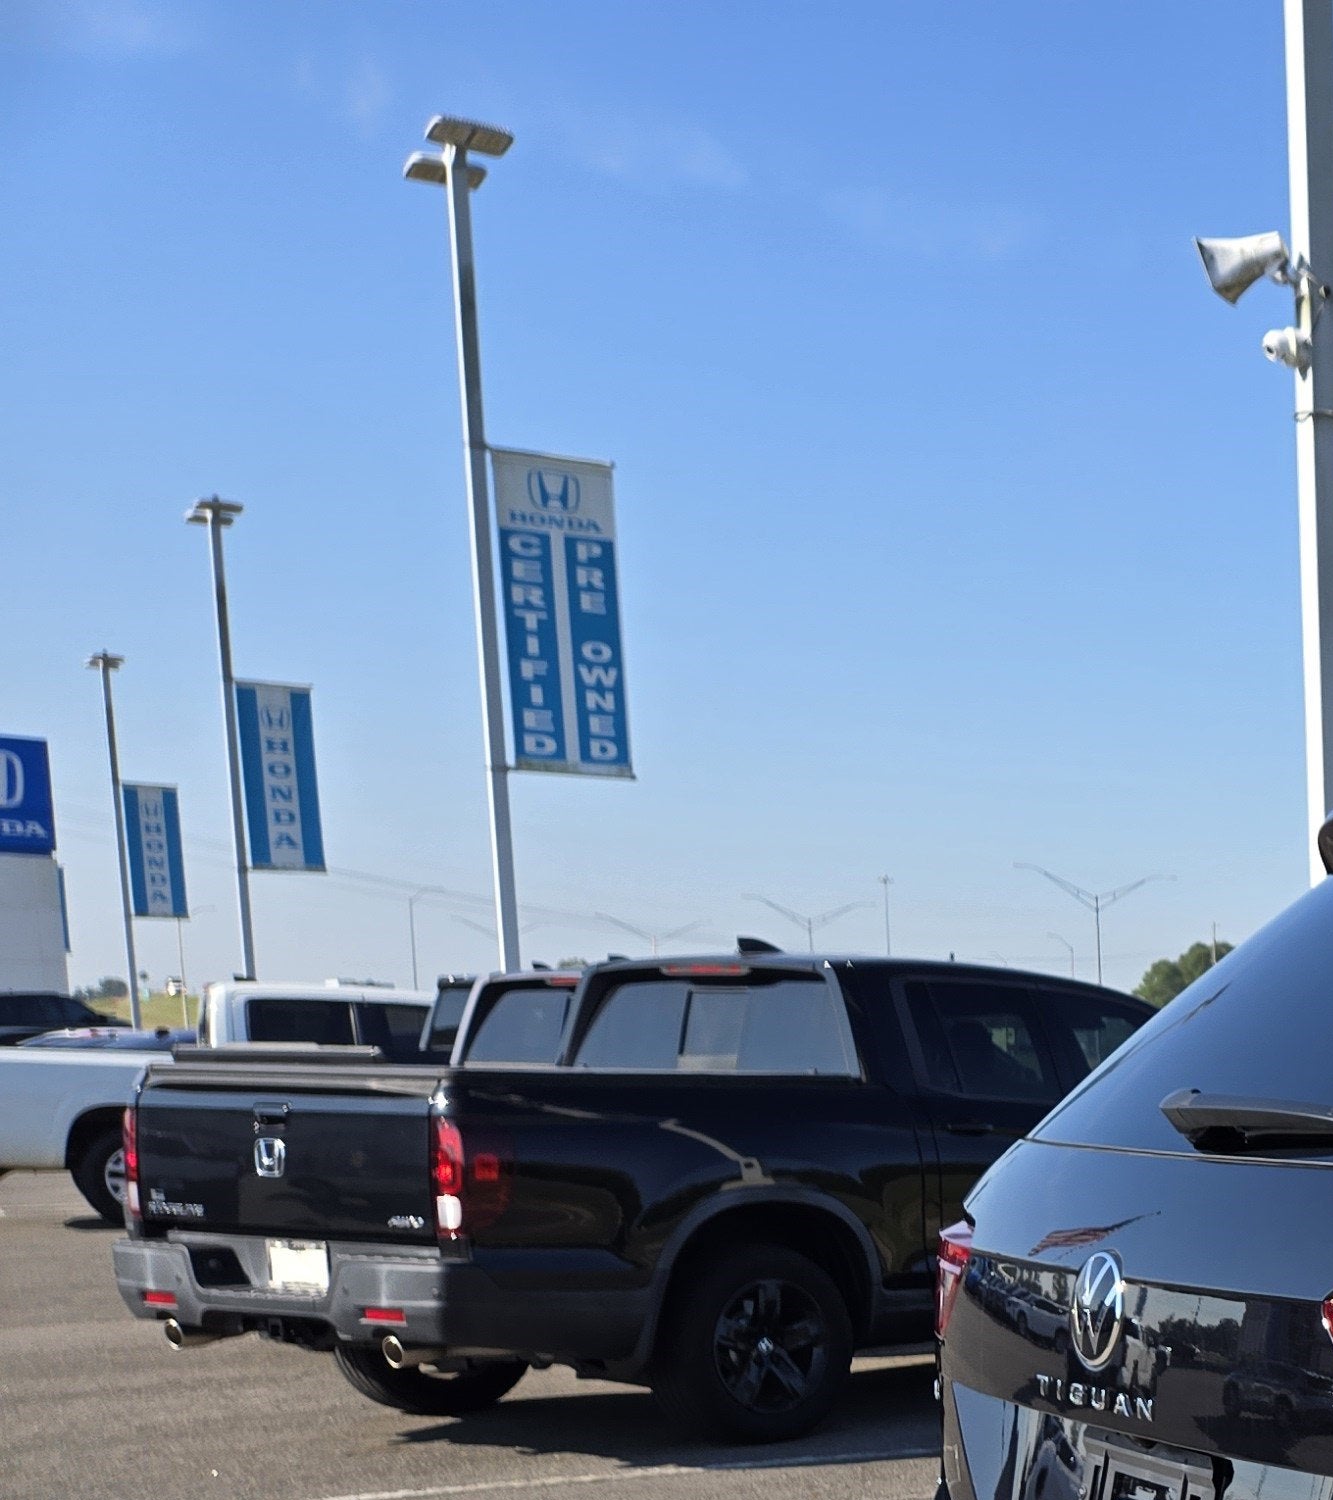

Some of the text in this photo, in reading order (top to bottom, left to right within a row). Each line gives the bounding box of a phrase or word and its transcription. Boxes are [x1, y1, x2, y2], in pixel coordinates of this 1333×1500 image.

[509, 509, 602, 533] HONDA
[508, 533, 558, 756] CERTIFIED
[576, 540, 619, 761] PRE OWNED
[265, 736, 299, 850] HONDA
[1036, 1373, 1154, 1422] TIGUAN
